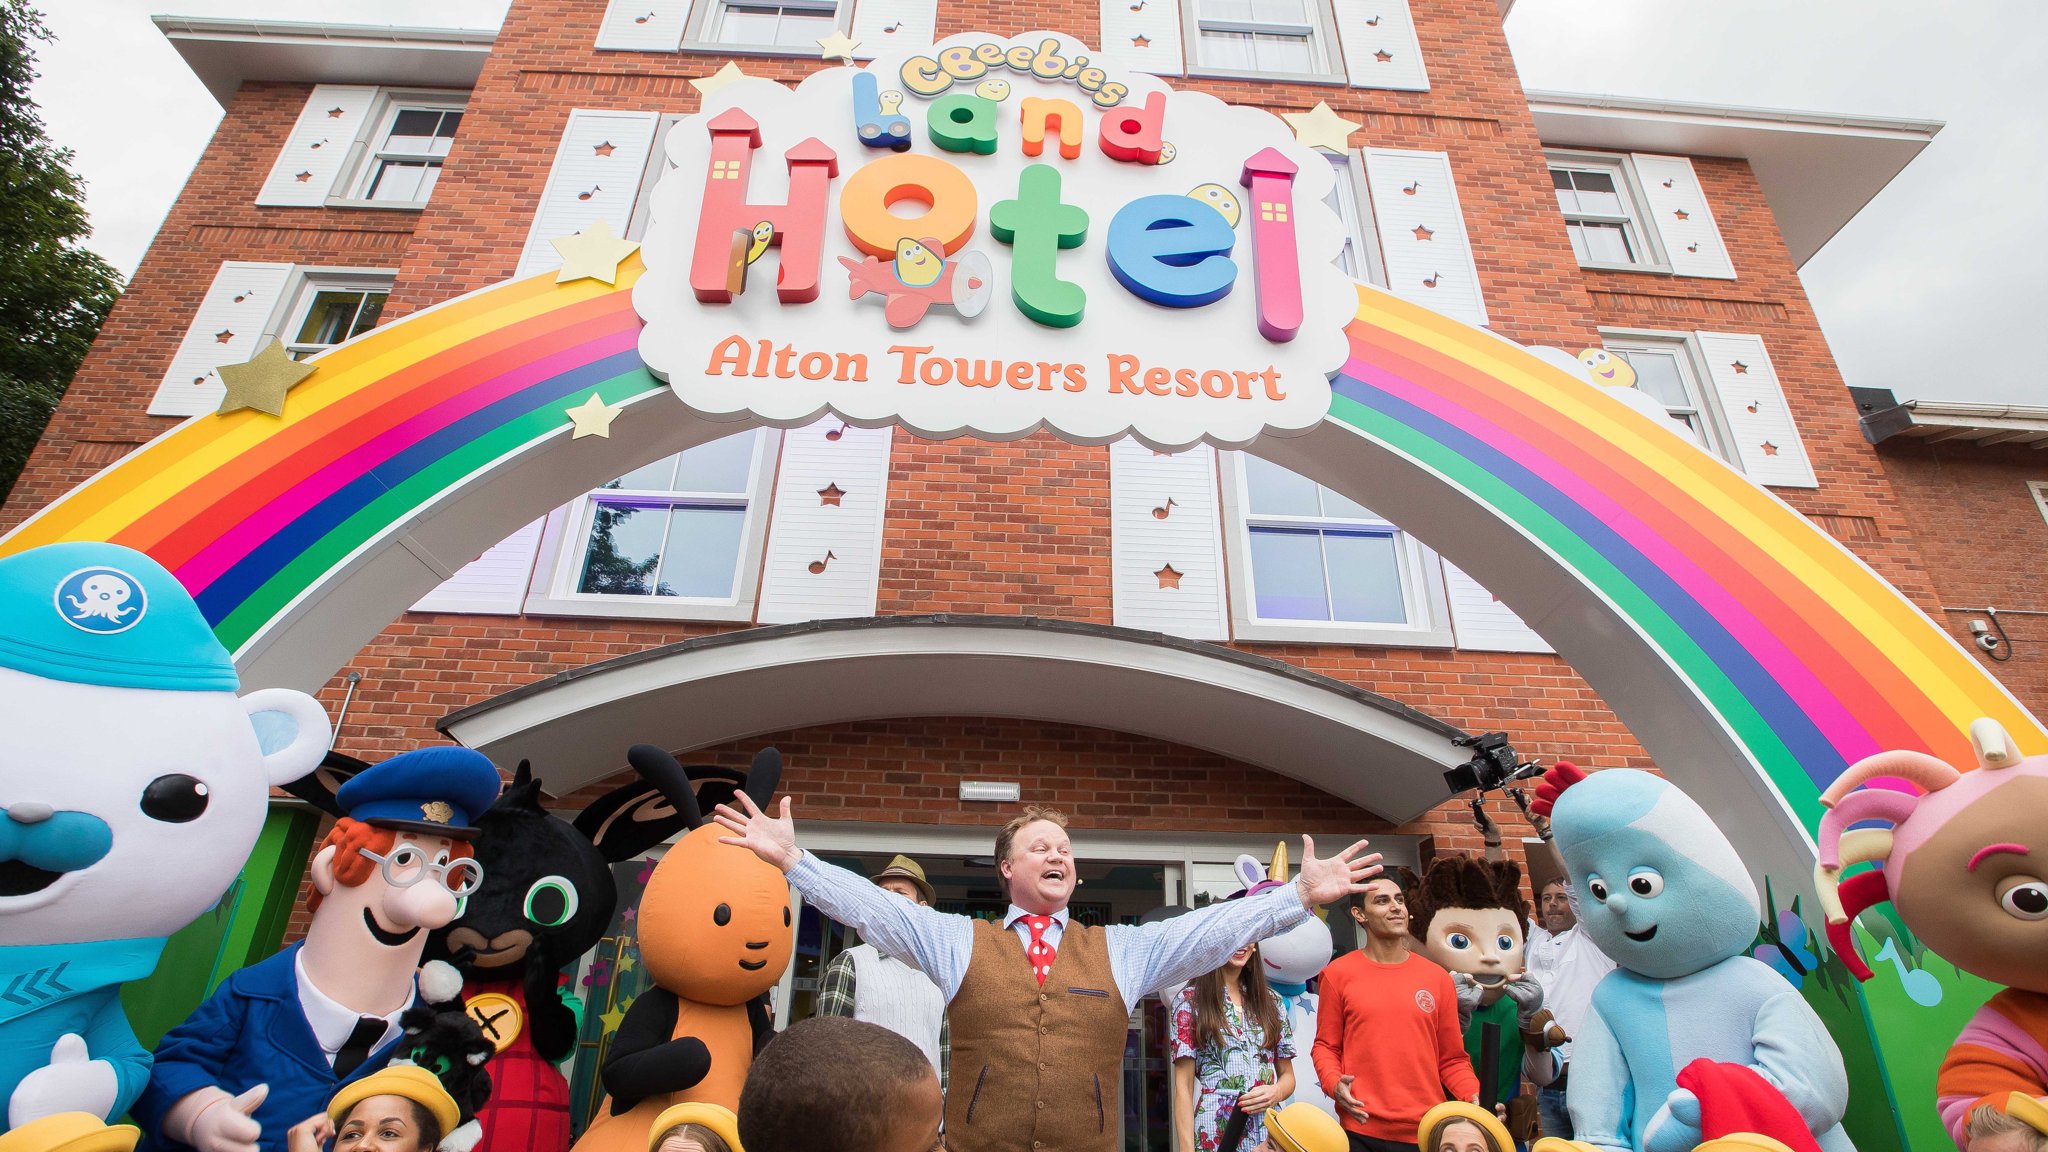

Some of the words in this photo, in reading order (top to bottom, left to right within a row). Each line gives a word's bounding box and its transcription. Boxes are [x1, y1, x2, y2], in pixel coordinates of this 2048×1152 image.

[899, 38, 1128, 108] CBeebies
[852, 71, 1166, 165] Land
[689, 106, 1304, 343] Hotel
[704, 333, 869, 383] Alton
[887, 344, 1088, 393] Towers
[1107, 353, 1288, 401] Resort
